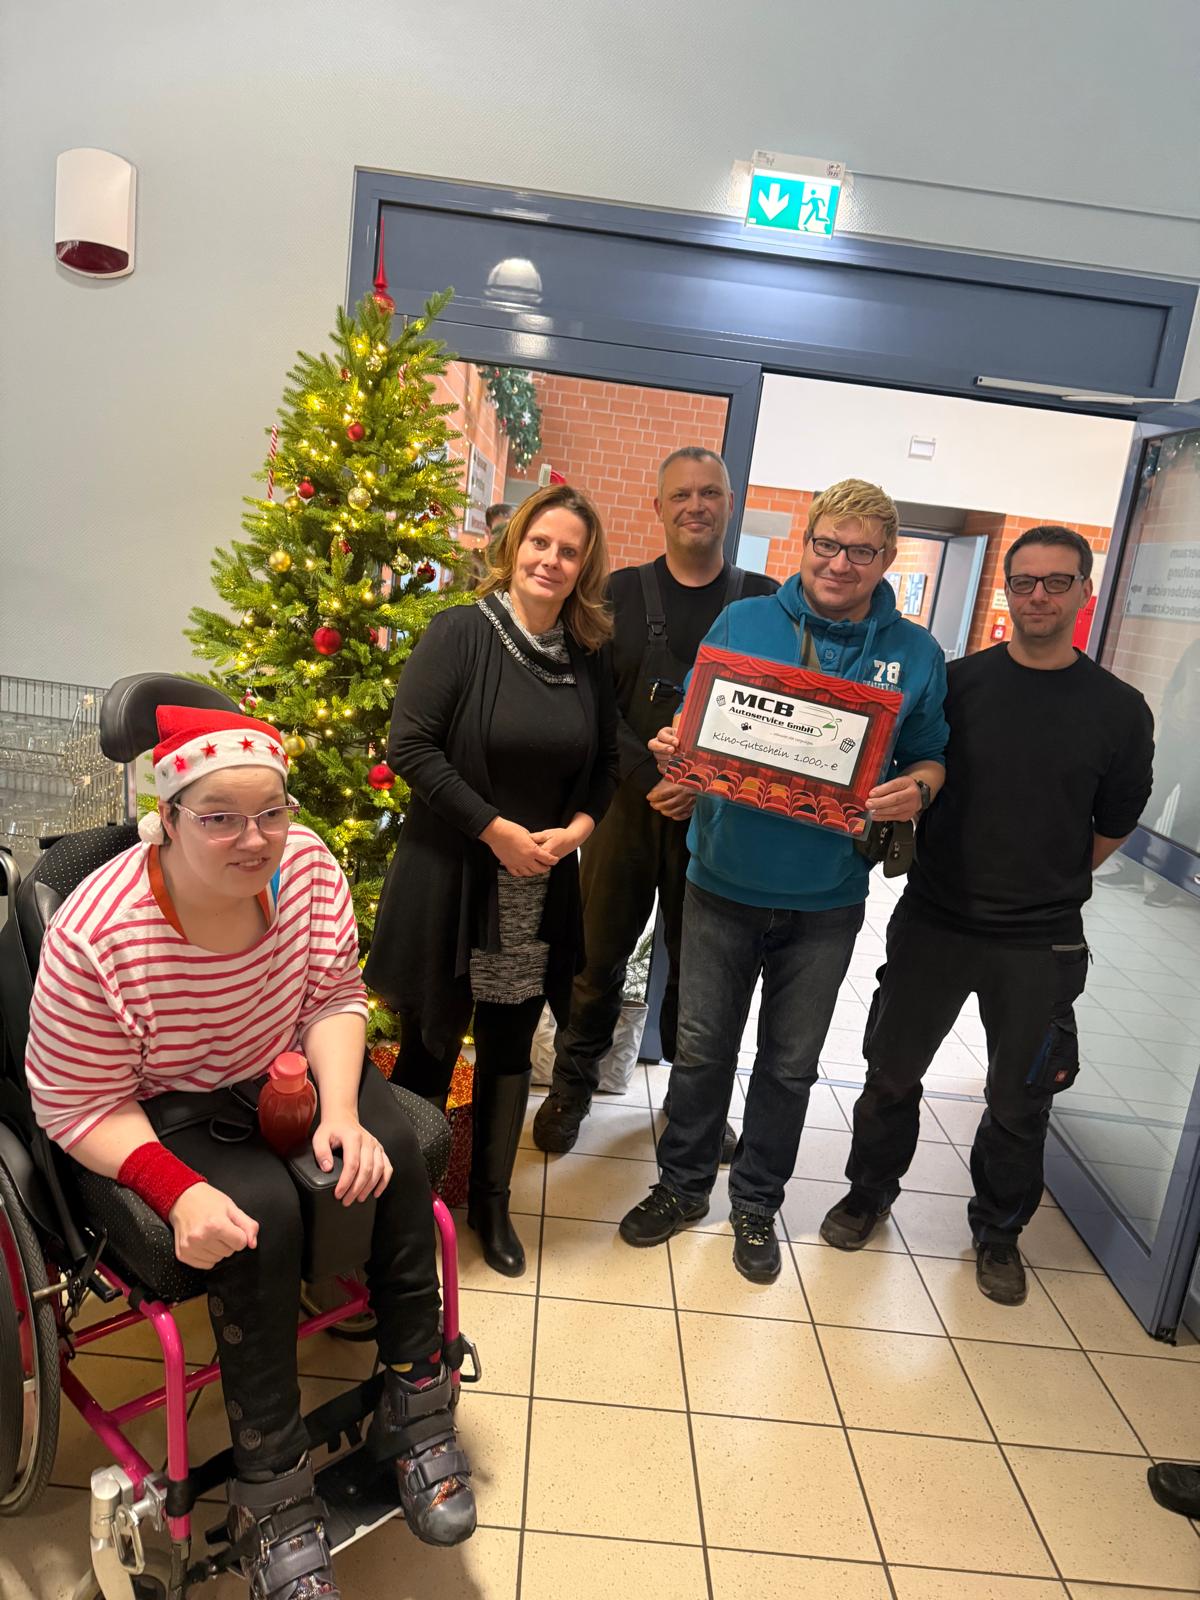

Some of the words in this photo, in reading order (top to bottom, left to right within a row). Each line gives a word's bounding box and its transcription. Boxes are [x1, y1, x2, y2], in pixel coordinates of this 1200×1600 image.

[873, 659, 900, 685] 78
[732, 690, 795, 718] MCB
[729, 706, 785, 726] Autoservice
[787, 722, 814, 734] GmbH
[713, 731, 790, 759] Kino-Gutschein
